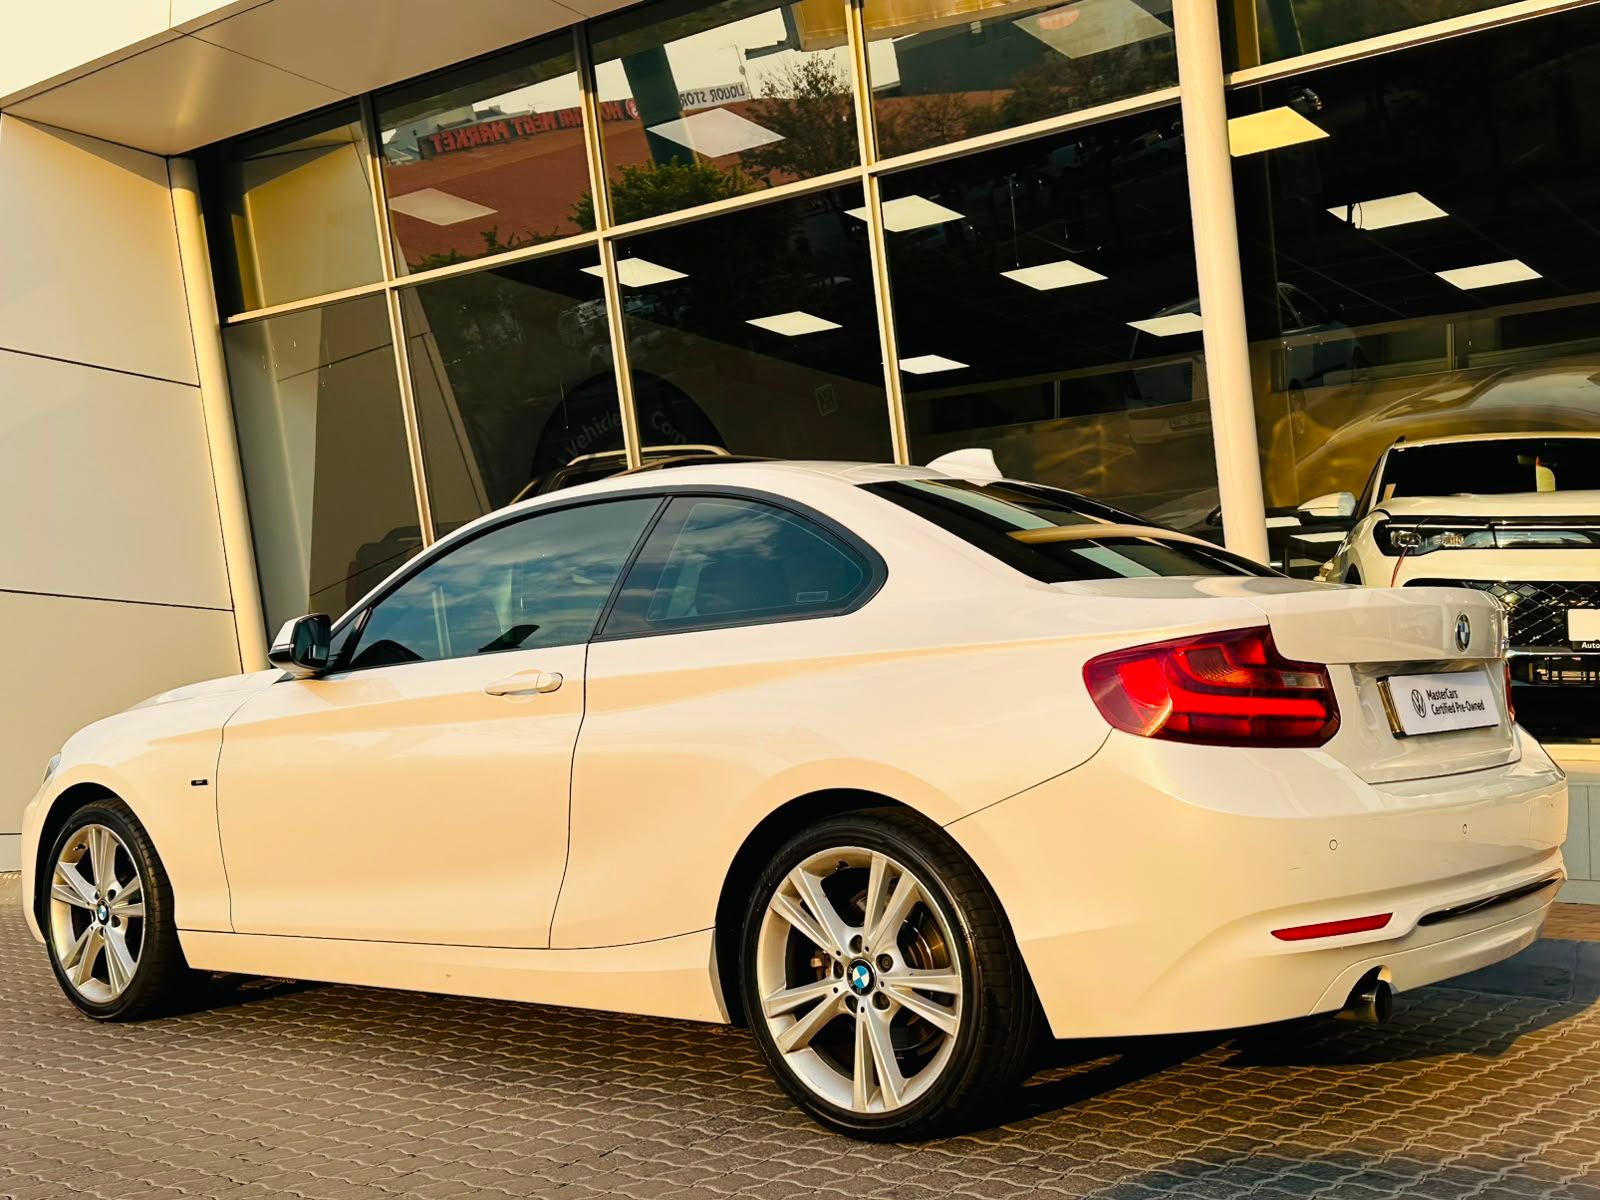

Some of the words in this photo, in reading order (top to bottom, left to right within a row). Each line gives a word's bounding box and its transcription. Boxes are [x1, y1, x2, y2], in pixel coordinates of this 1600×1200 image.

[1425, 688, 1459, 701] MasterCars
[1431, 702, 1456, 715] Certified
[1455, 699, 1485, 713] Pre-Owned
